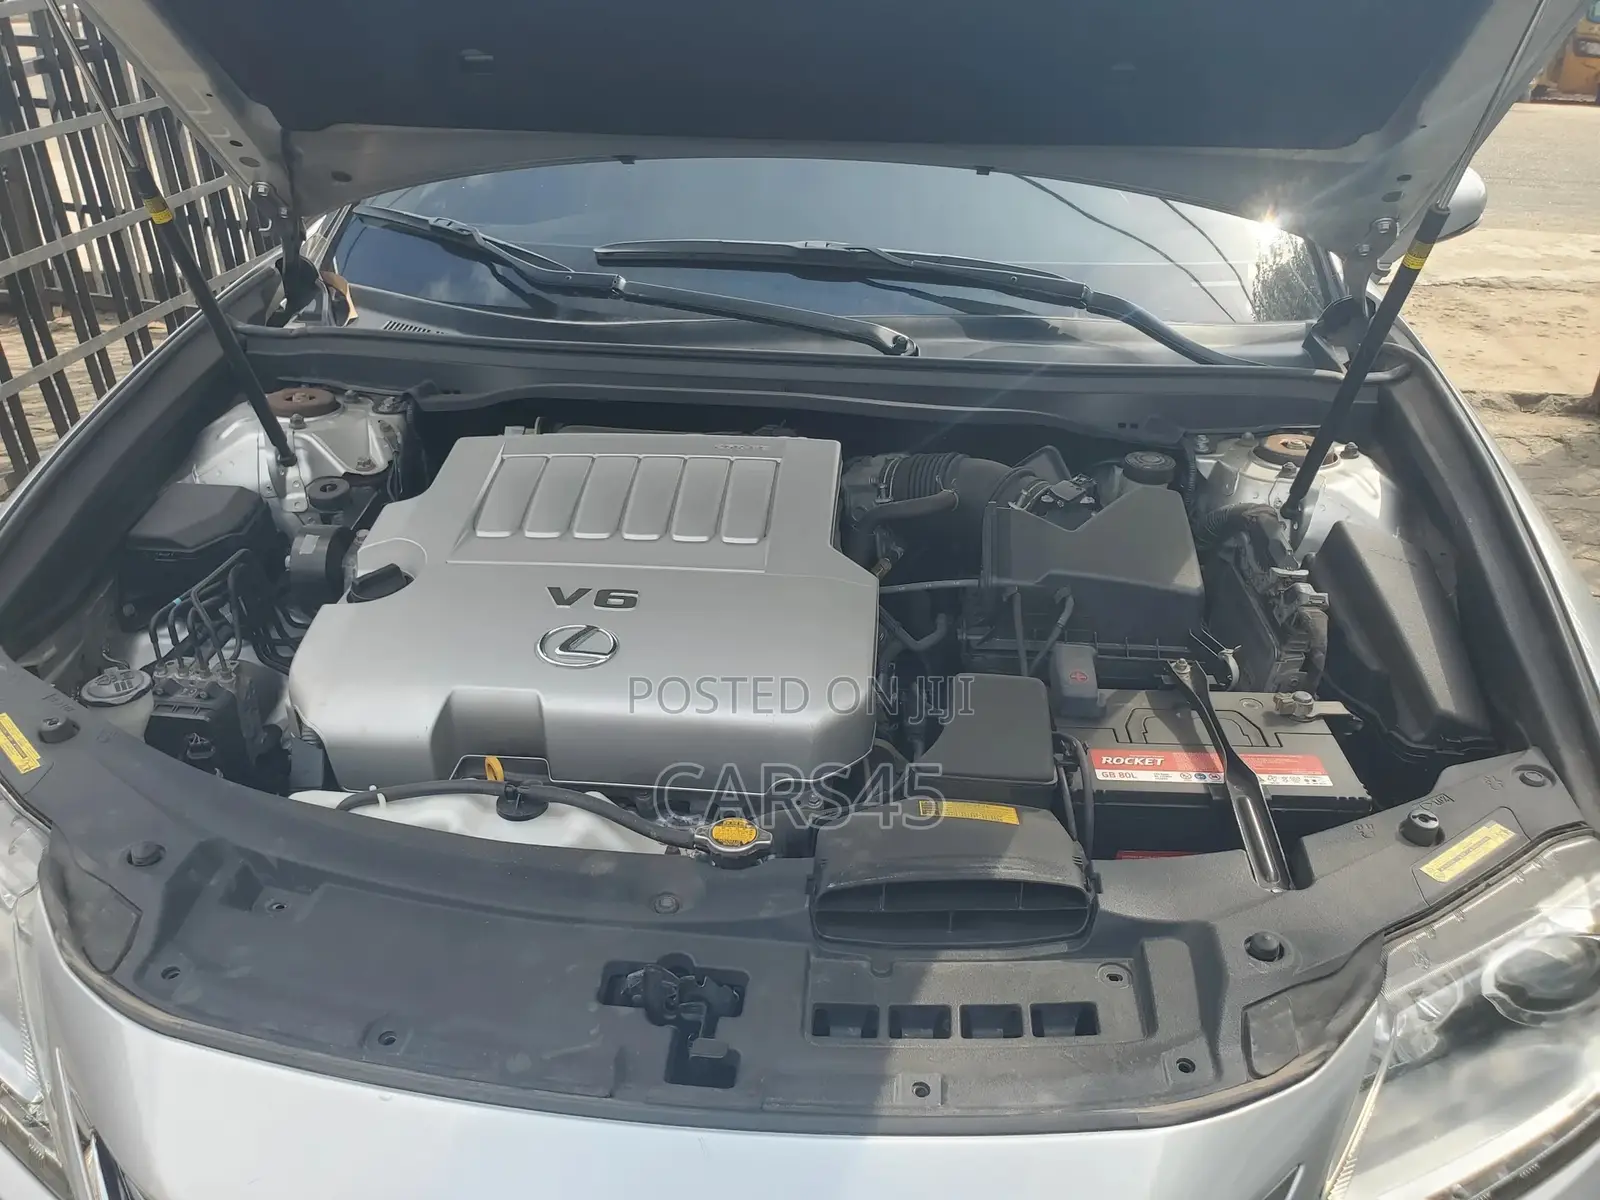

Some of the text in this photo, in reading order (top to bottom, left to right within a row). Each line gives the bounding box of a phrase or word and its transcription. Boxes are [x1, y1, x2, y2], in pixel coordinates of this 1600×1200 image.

[546, 586, 641, 611] V6
[1101, 756, 1165, 766] ROCKET
[1101, 771, 1137, 779] GB 80L
